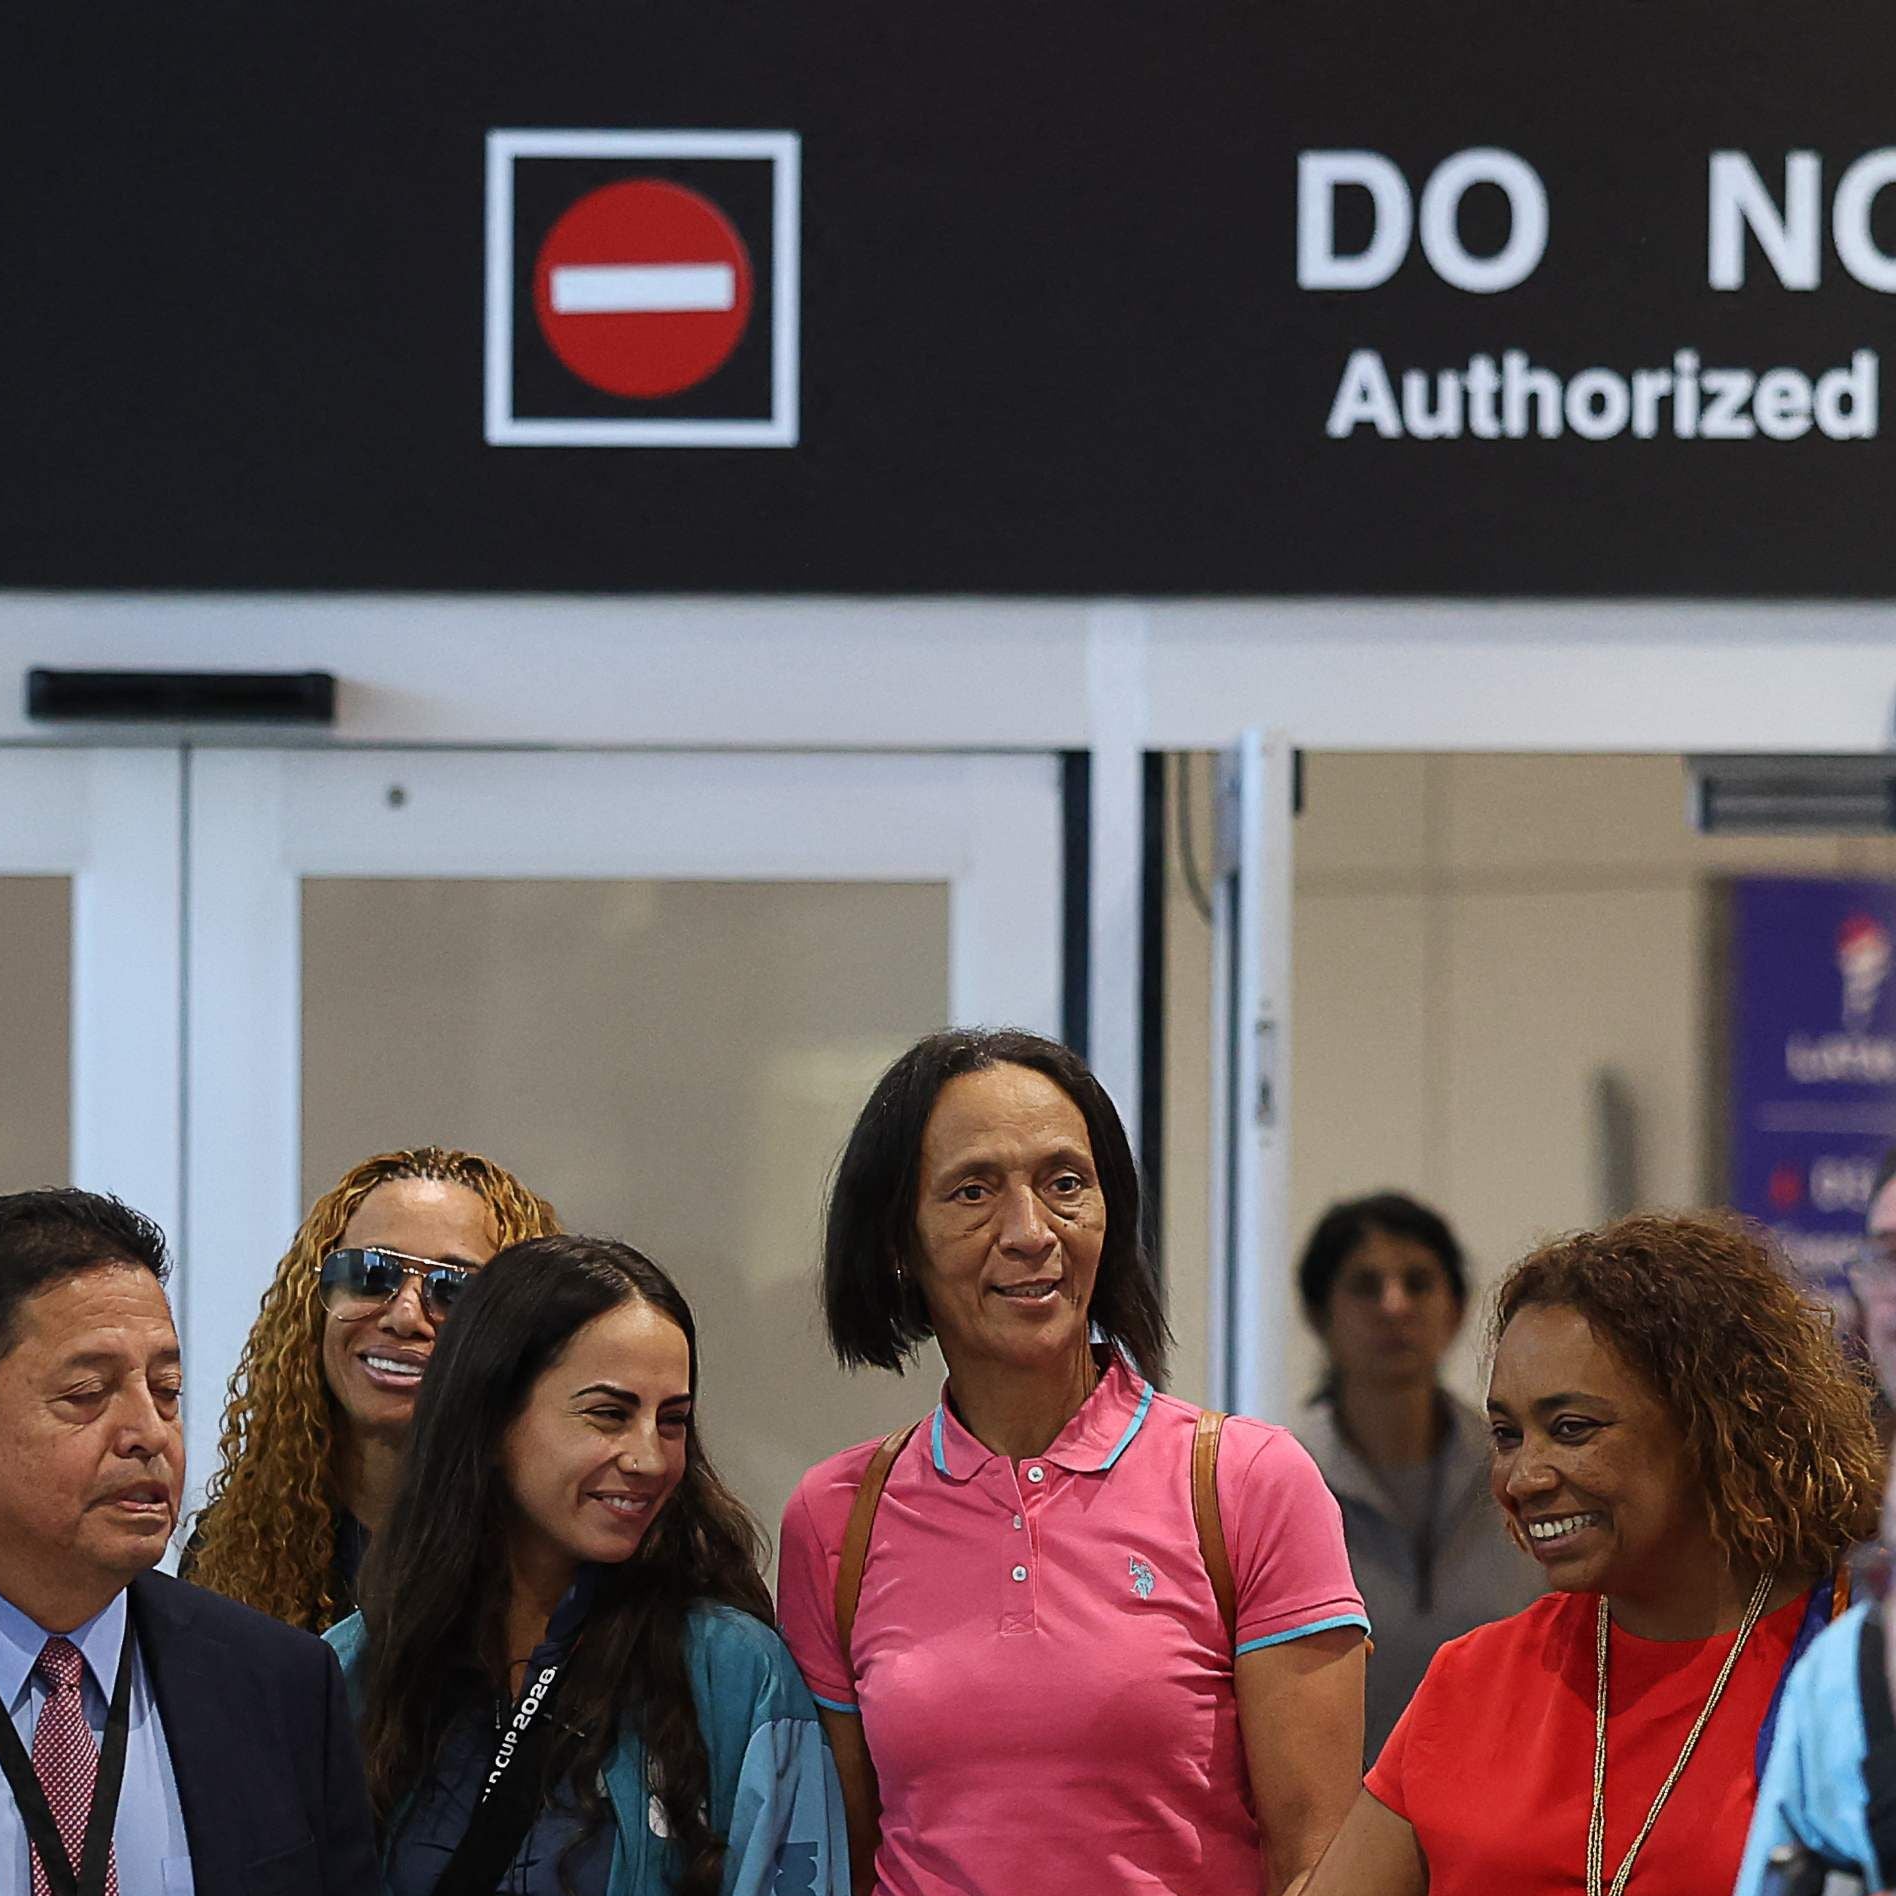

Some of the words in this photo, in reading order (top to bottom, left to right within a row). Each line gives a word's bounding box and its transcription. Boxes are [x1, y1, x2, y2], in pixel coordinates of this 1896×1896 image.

[1298, 150, 1547, 292] DO
[1328, 350, 1877, 439] Authorized
[495, 1731, 518, 1769] CUP
[512, 1667, 556, 1731] 2026
